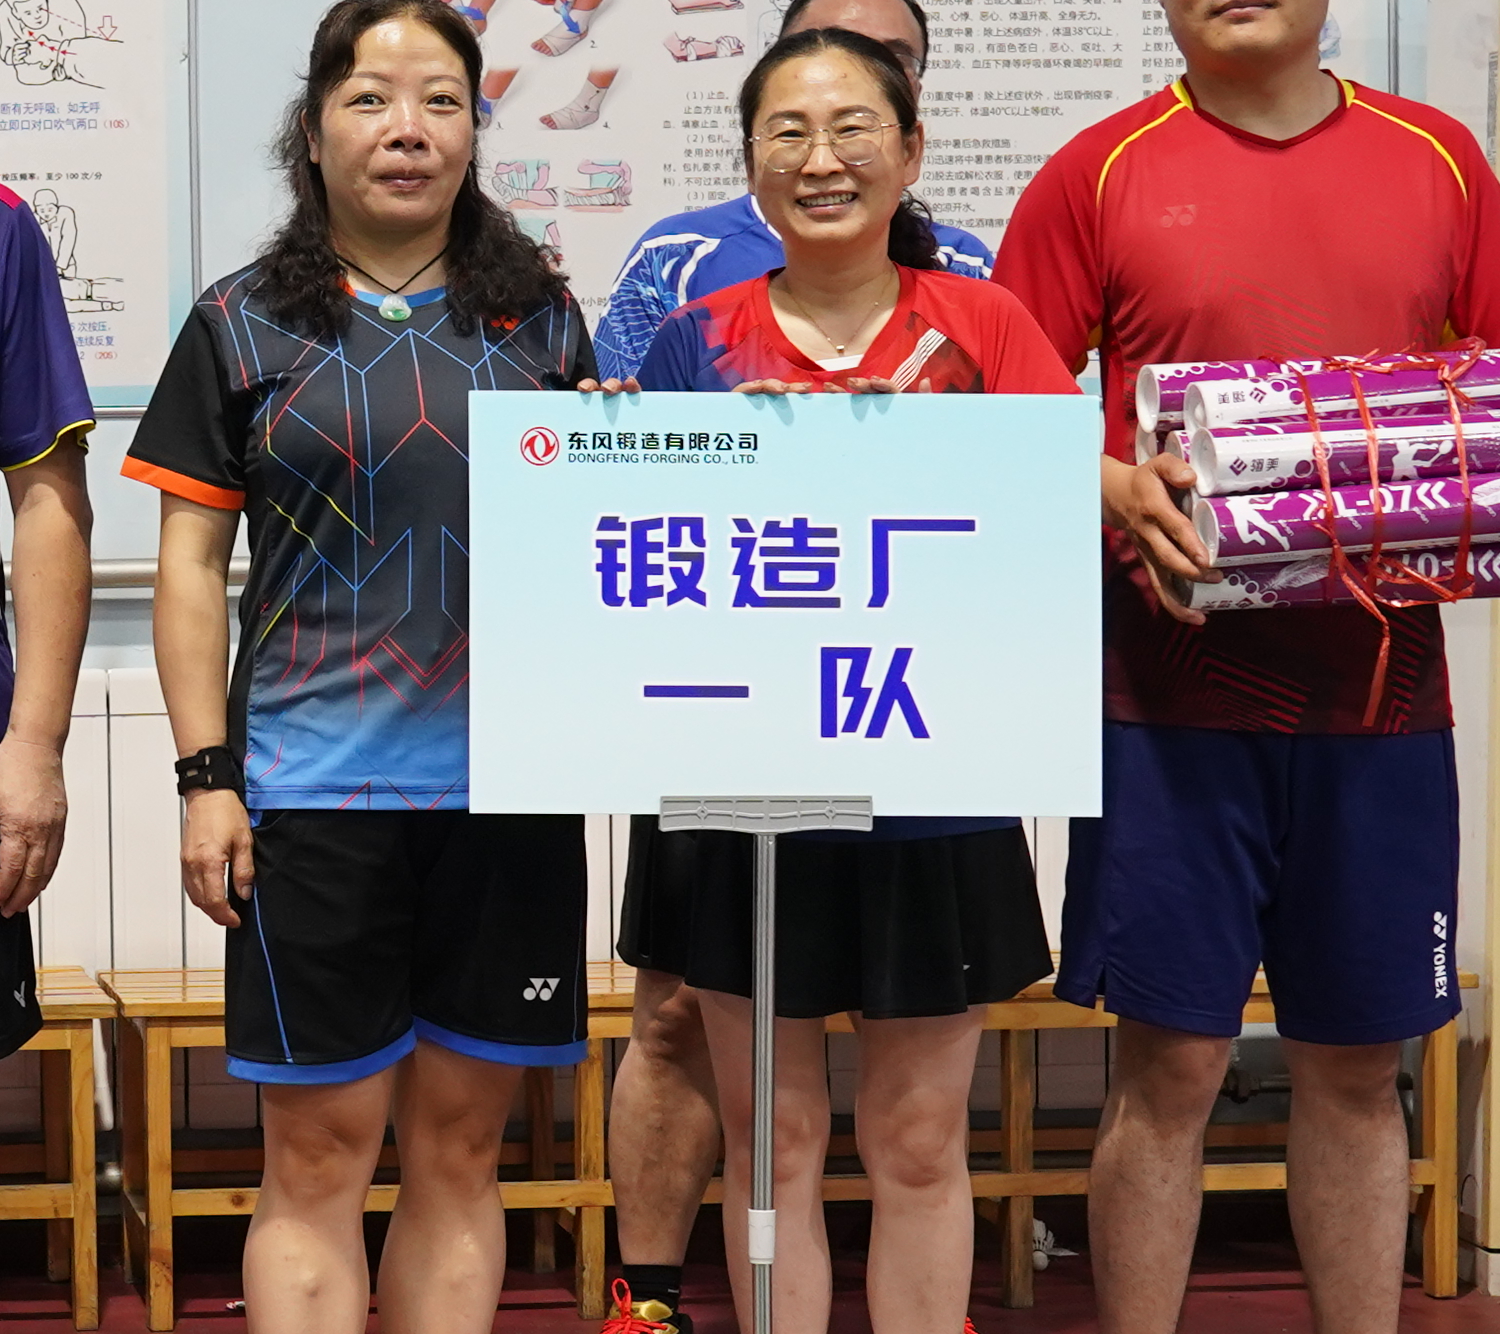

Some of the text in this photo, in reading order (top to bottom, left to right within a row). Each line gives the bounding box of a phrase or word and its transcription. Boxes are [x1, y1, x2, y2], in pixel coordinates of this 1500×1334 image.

[567, 431, 759, 452] 东风锻造有限公司
[567, 453, 639, 465] DONGFENG
[642, 453, 702, 464] FORGING
[731, 453, 759, 465] LTD.
[1331, 483, 1413, 518] L-07
[595, 515, 977, 609] 锻造厂
[643, 646, 932, 739] 一队
[1433, 942, 1448, 999] YONEX
